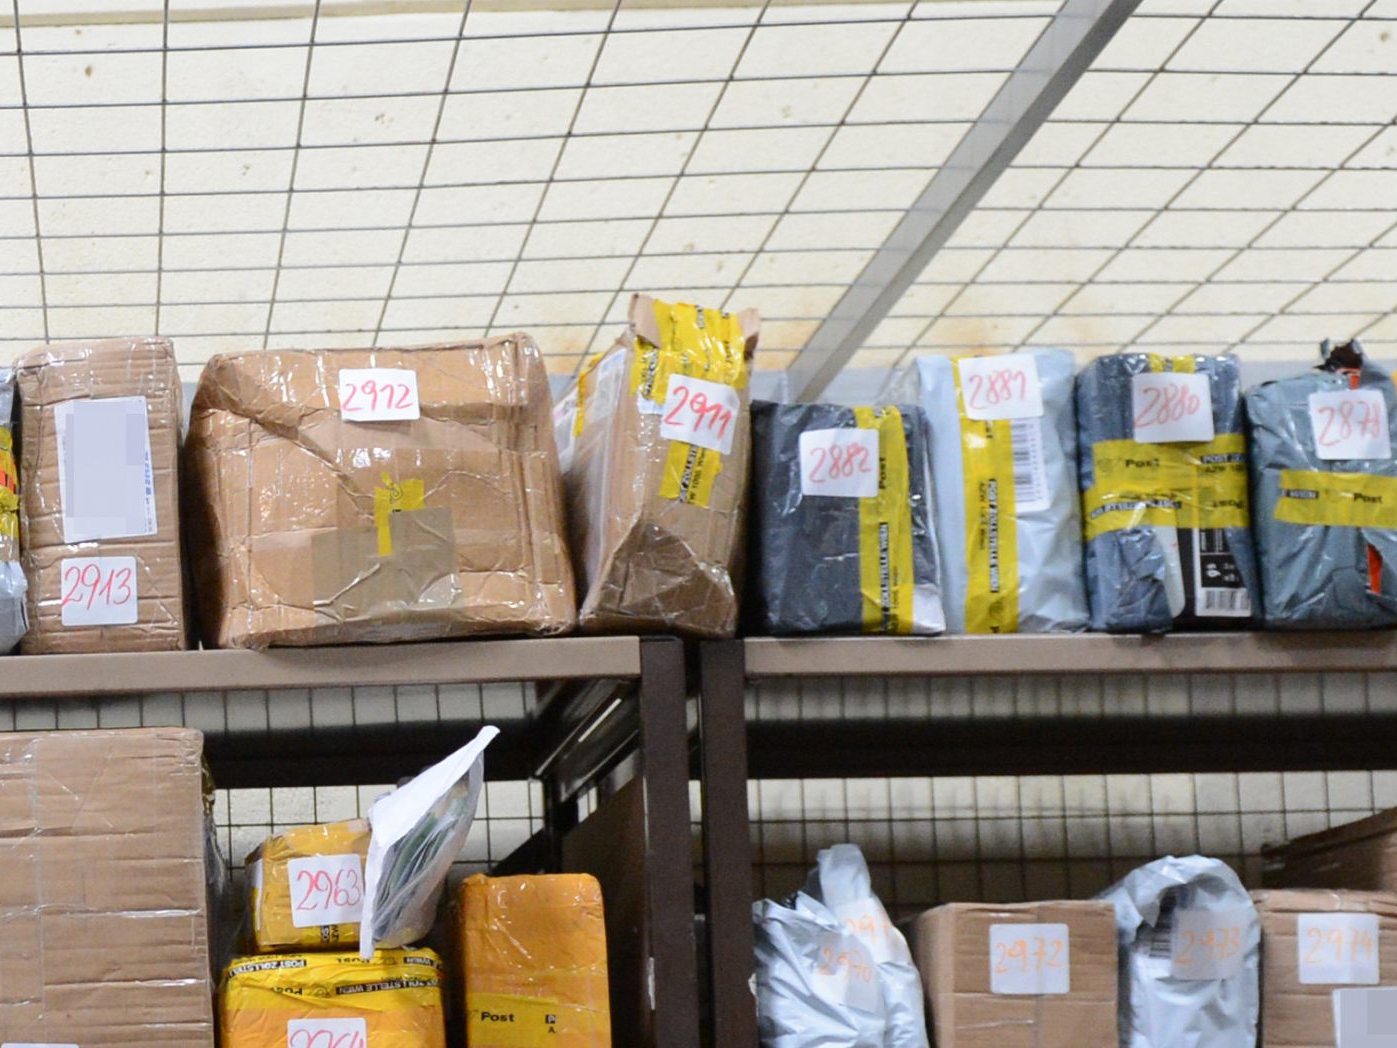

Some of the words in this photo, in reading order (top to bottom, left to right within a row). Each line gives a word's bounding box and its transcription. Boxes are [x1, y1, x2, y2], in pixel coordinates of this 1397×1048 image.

[342, 379, 414, 413] 2912
[663, 385, 732, 439] 2911
[809, 442, 872, 484] 2882
[1125, 458, 1160, 469] Post
[1353, 492, 1383, 504] Post
[62, 563, 133, 611] 2913
[296, 868, 361, 913] 2963
[279, 958, 306, 968] POST
[338, 985, 366, 995] WIEN
[480, 1011, 516, 1023] Post
